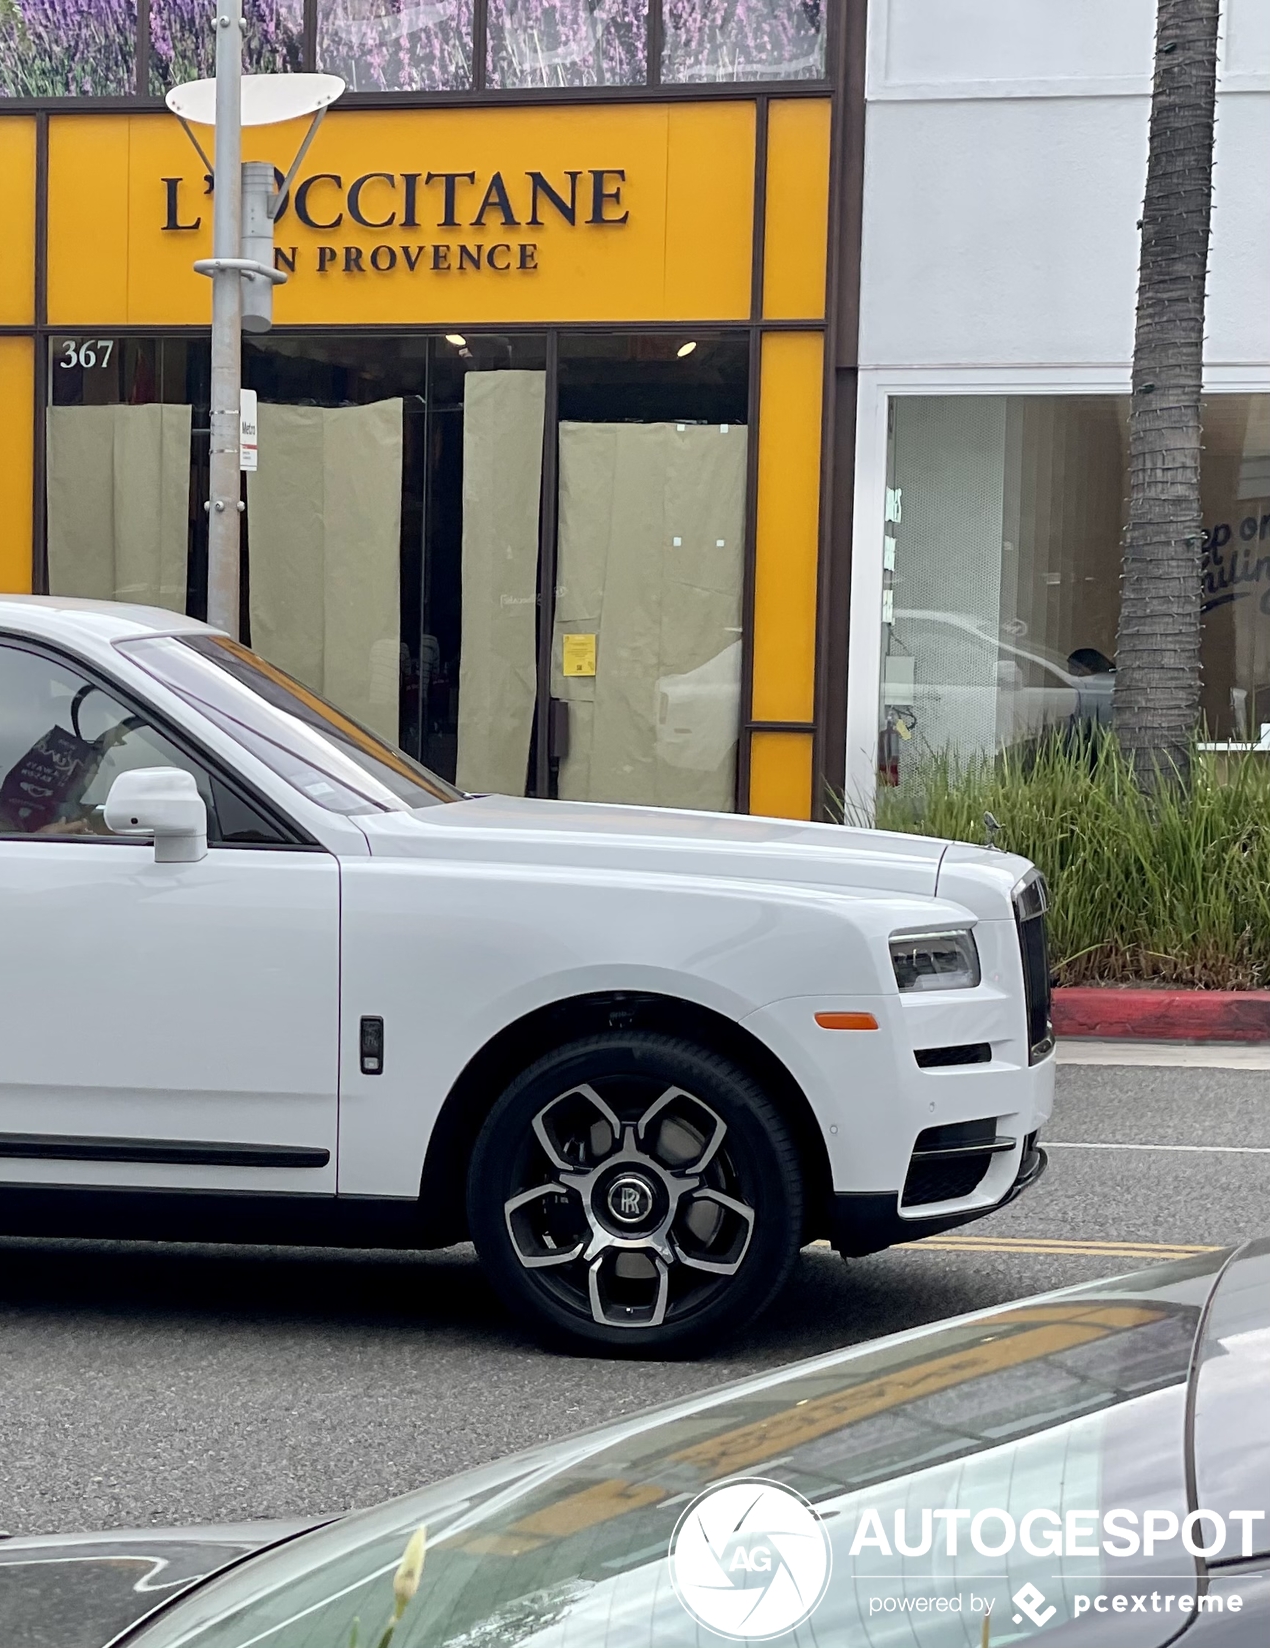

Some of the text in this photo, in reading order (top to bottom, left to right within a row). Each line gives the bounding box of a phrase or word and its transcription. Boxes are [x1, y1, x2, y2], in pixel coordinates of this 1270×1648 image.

[161, 166, 630, 231] L'CCITANE
[275, 243, 540, 273] N PROVENCE
[60, 339, 114, 369] 367
